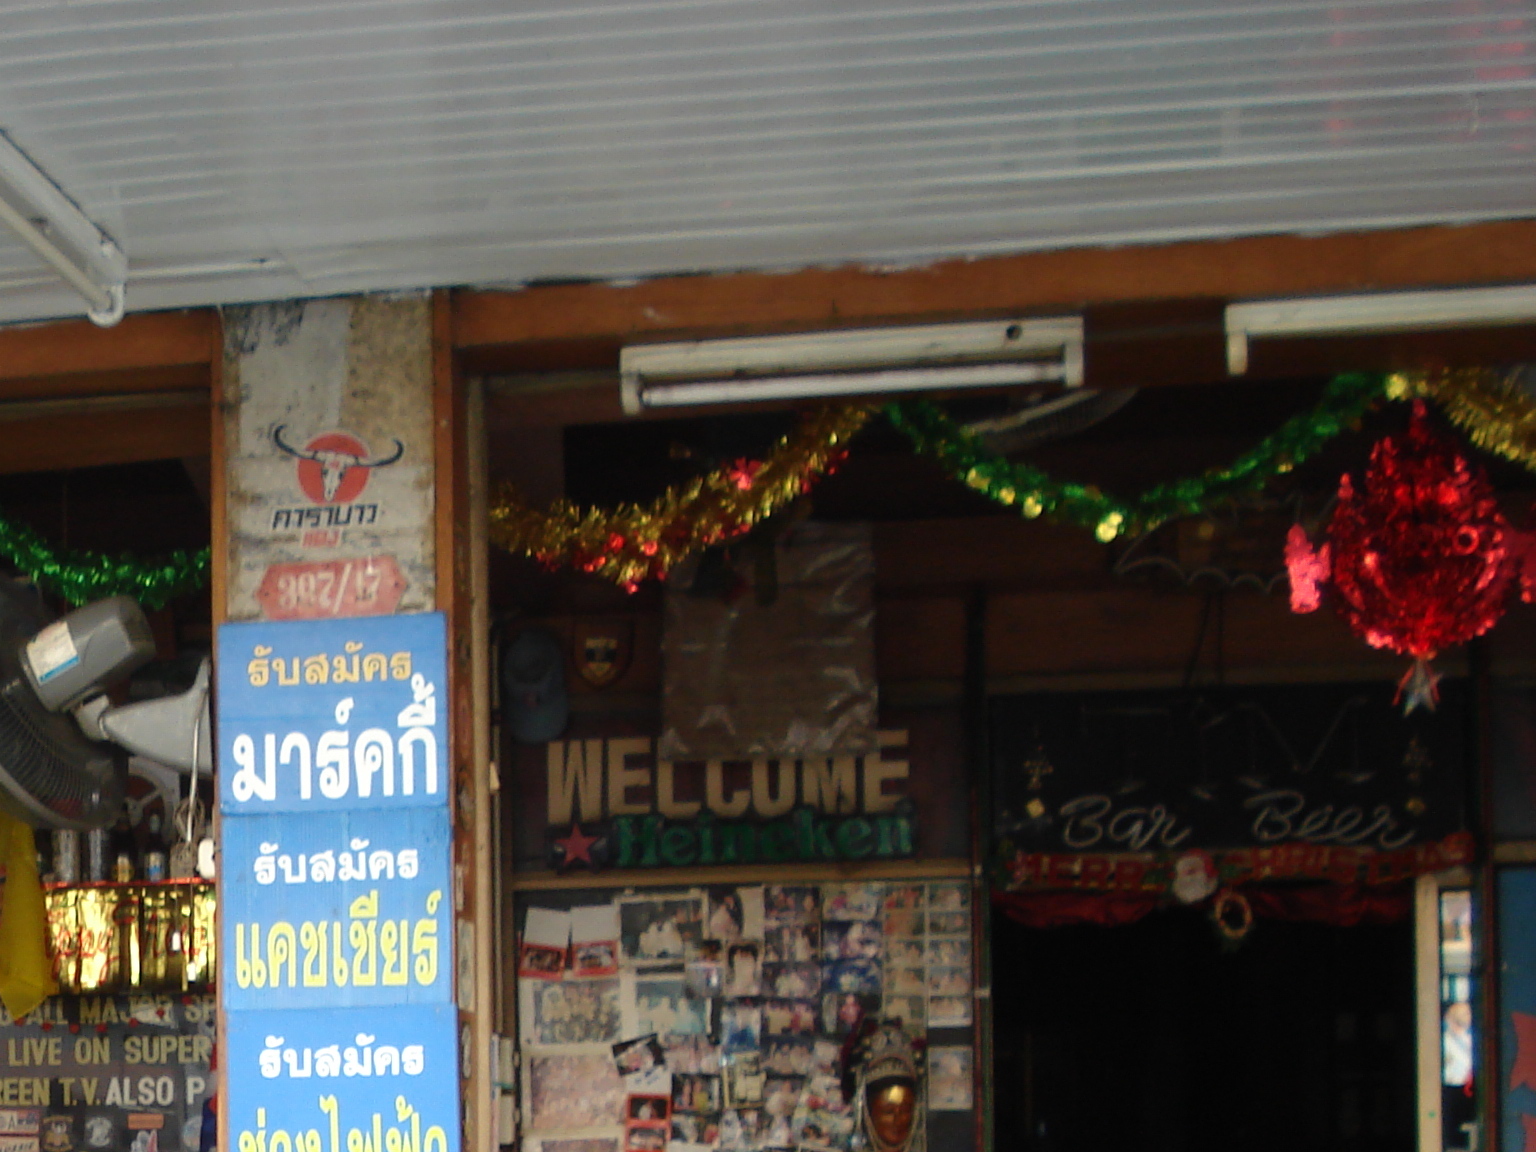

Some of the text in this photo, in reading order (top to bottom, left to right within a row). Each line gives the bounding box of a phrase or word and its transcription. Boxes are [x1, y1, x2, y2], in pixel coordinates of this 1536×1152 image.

[247, 641, 412, 687] รับสมัคร
[232, 673, 438, 802] มาร์คกี้
[547, 730, 910, 825] WELCOME
[615, 806, 914, 867] Heineken
[1061, 789, 1416, 851] Bar Beer
[253, 837, 418, 885] รับสมัคร
[235, 890, 441, 988] แคชเชียร์
[26, 996, 69, 1026] ALL
[8, 1037, 62, 1067] LIVE
[74, 1036, 111, 1065] ON
[124, 1034, 212, 1065] SUPER
[259, 1033, 424, 1079] รับสมัคร
[105, 1075, 174, 1107] ALSO
